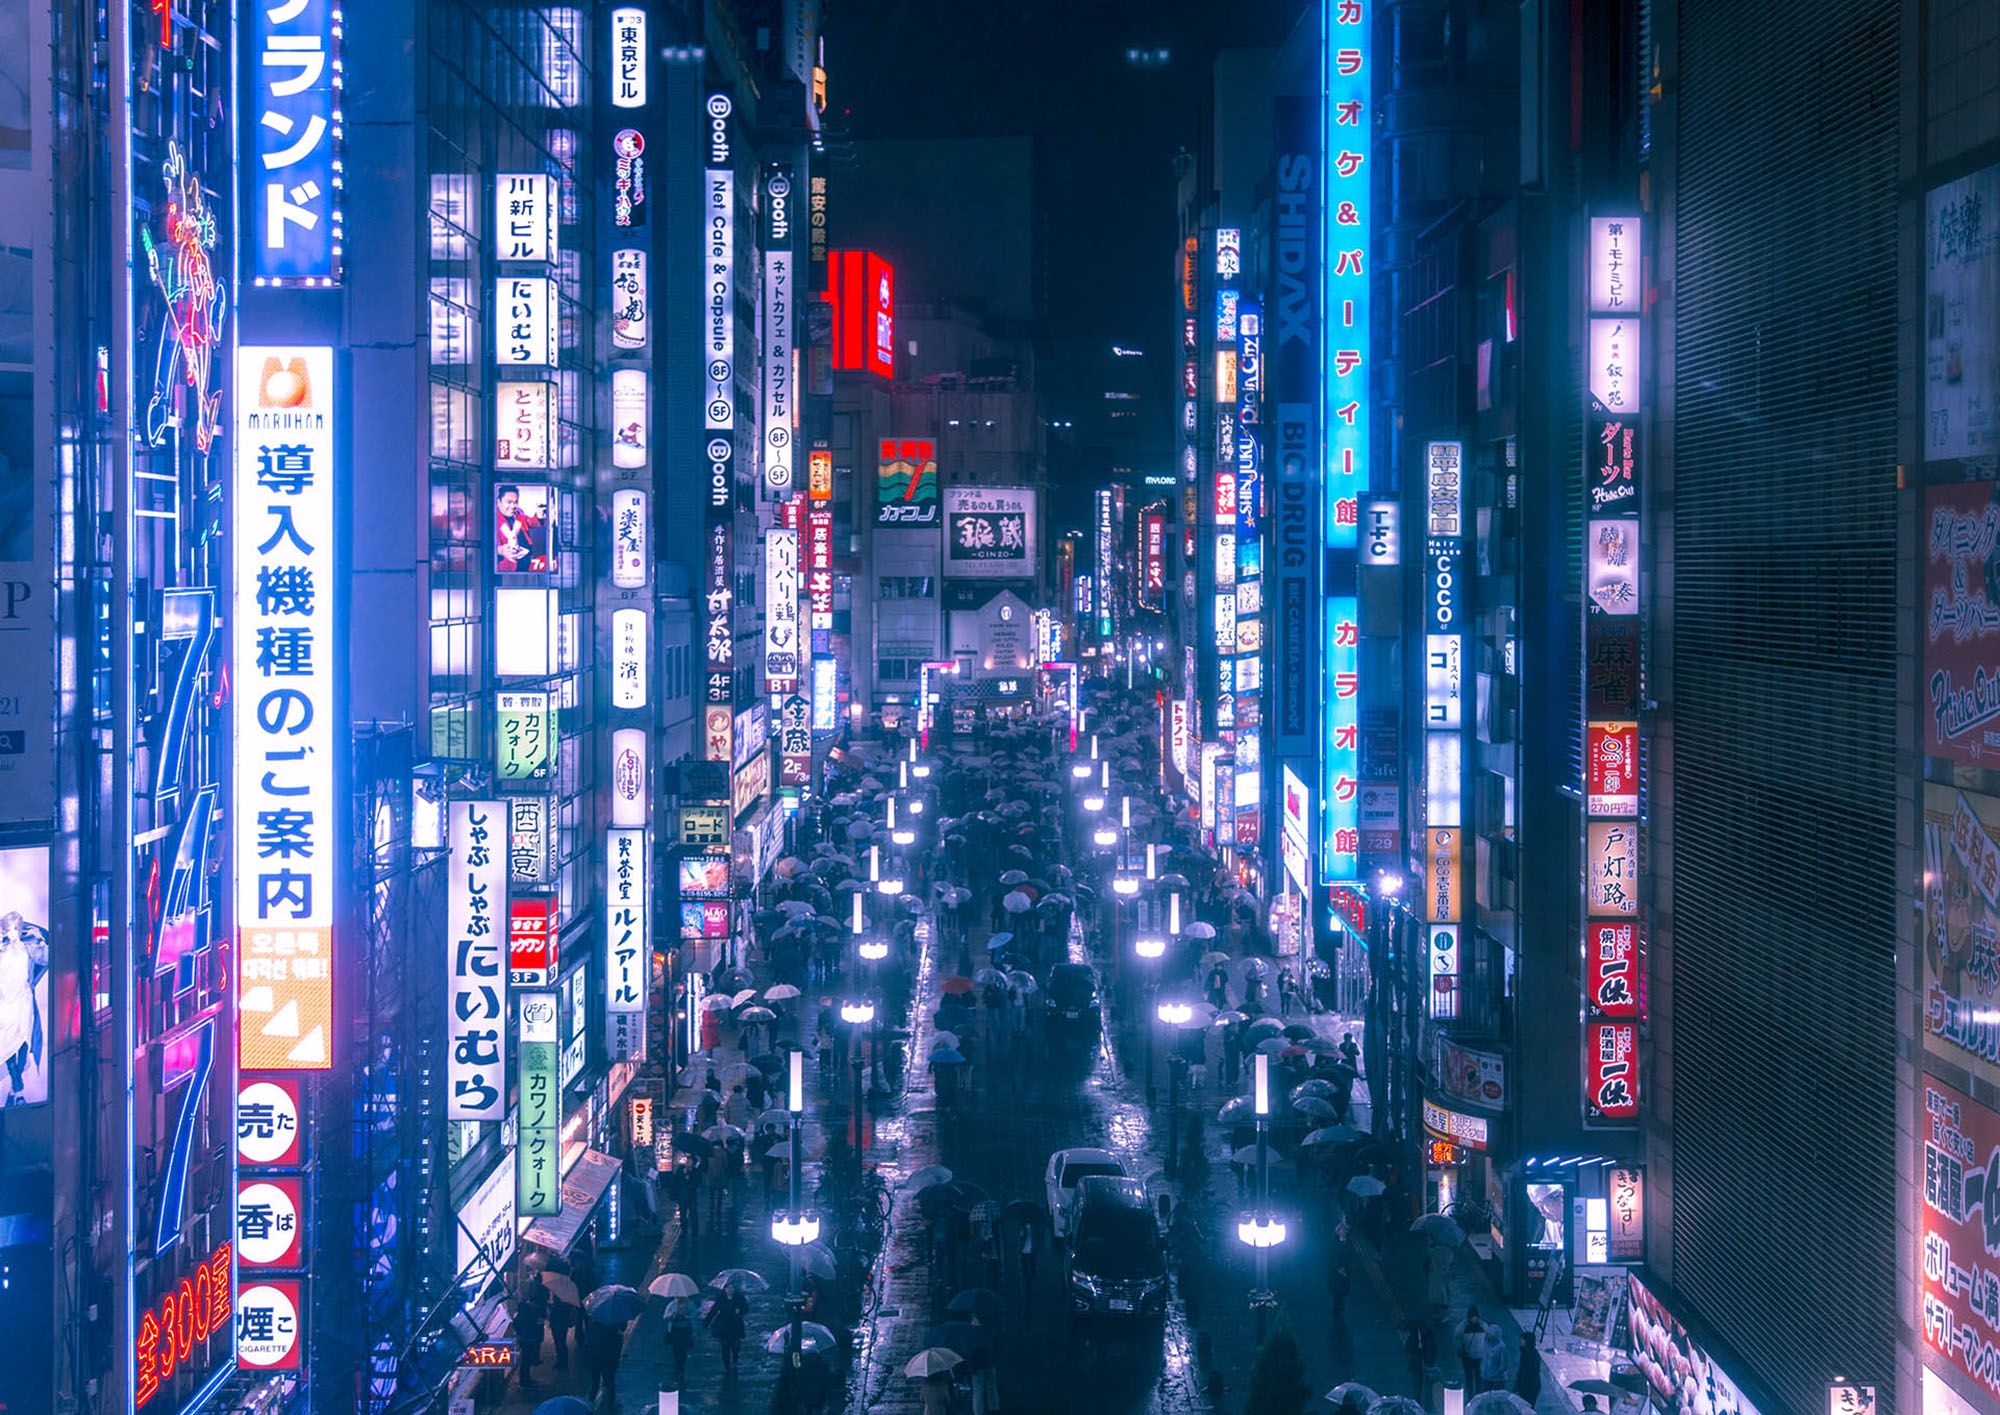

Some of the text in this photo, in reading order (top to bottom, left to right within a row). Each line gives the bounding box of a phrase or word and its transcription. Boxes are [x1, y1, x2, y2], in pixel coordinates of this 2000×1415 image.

[620, 26, 638, 98] 東京ビル
[707, 94, 732, 162] Booth
[509, 178, 534, 258] 川新ビル
[768, 175, 791, 239] Booth
[711, 180, 727, 351] Net Cafe & Capsule
[1278, 153, 1312, 348] SHIDAX
[1607, 223, 1624, 308] 第1モナミビル
[511, 281, 532, 362] にいむら
[772, 260, 786, 338] ネットカフェ
[514, 389, 532, 463] ととりこ
[1601, 421, 1622, 486] ダーツ
[707, 438, 732, 506] Booth
[1238, 438, 1257, 515] SHINJUKU
[1283, 421, 1307, 568] BIC DRUG
[878, 504, 937, 522] カワノ
[1437, 556, 1453, 624] COCO
[256, 444, 315, 919] 導入機種のご案内
[708, 673, 731, 688] 4F
[708, 688, 731, 701] 3F
[770, 679, 791, 692] B1
[783, 693, 811, 754] 金の蔵
[1173, 703, 1184, 746] トラノコ
[1335, 621, 1358, 854] カラオケ館
[783, 758, 802, 773] 2F
[684, 819, 724, 832] ロード
[1591, 803, 1621, 814] 270円
[466, 803, 491, 937] しゃぶしゃぶ
[1366, 838, 1393, 850] 729
[1620, 901, 1635, 912] 4F
[614, 908, 640, 1004] ルノアール
[1598, 959, 1632, 1006] 一休
[455, 940, 500, 1111] にいむら
[1600, 1026, 1614, 1061] 居酒屋
[1598, 1061, 1632, 1107] 一休
[1923, 1140, 1964, 1227] 居酒屋
[1923, 1231, 2000, 1330] ボリューム満
[238, 1345, 288, 1353] CIGARETTE
[1923, 1291, 2000, 1394] サラリーマンの
